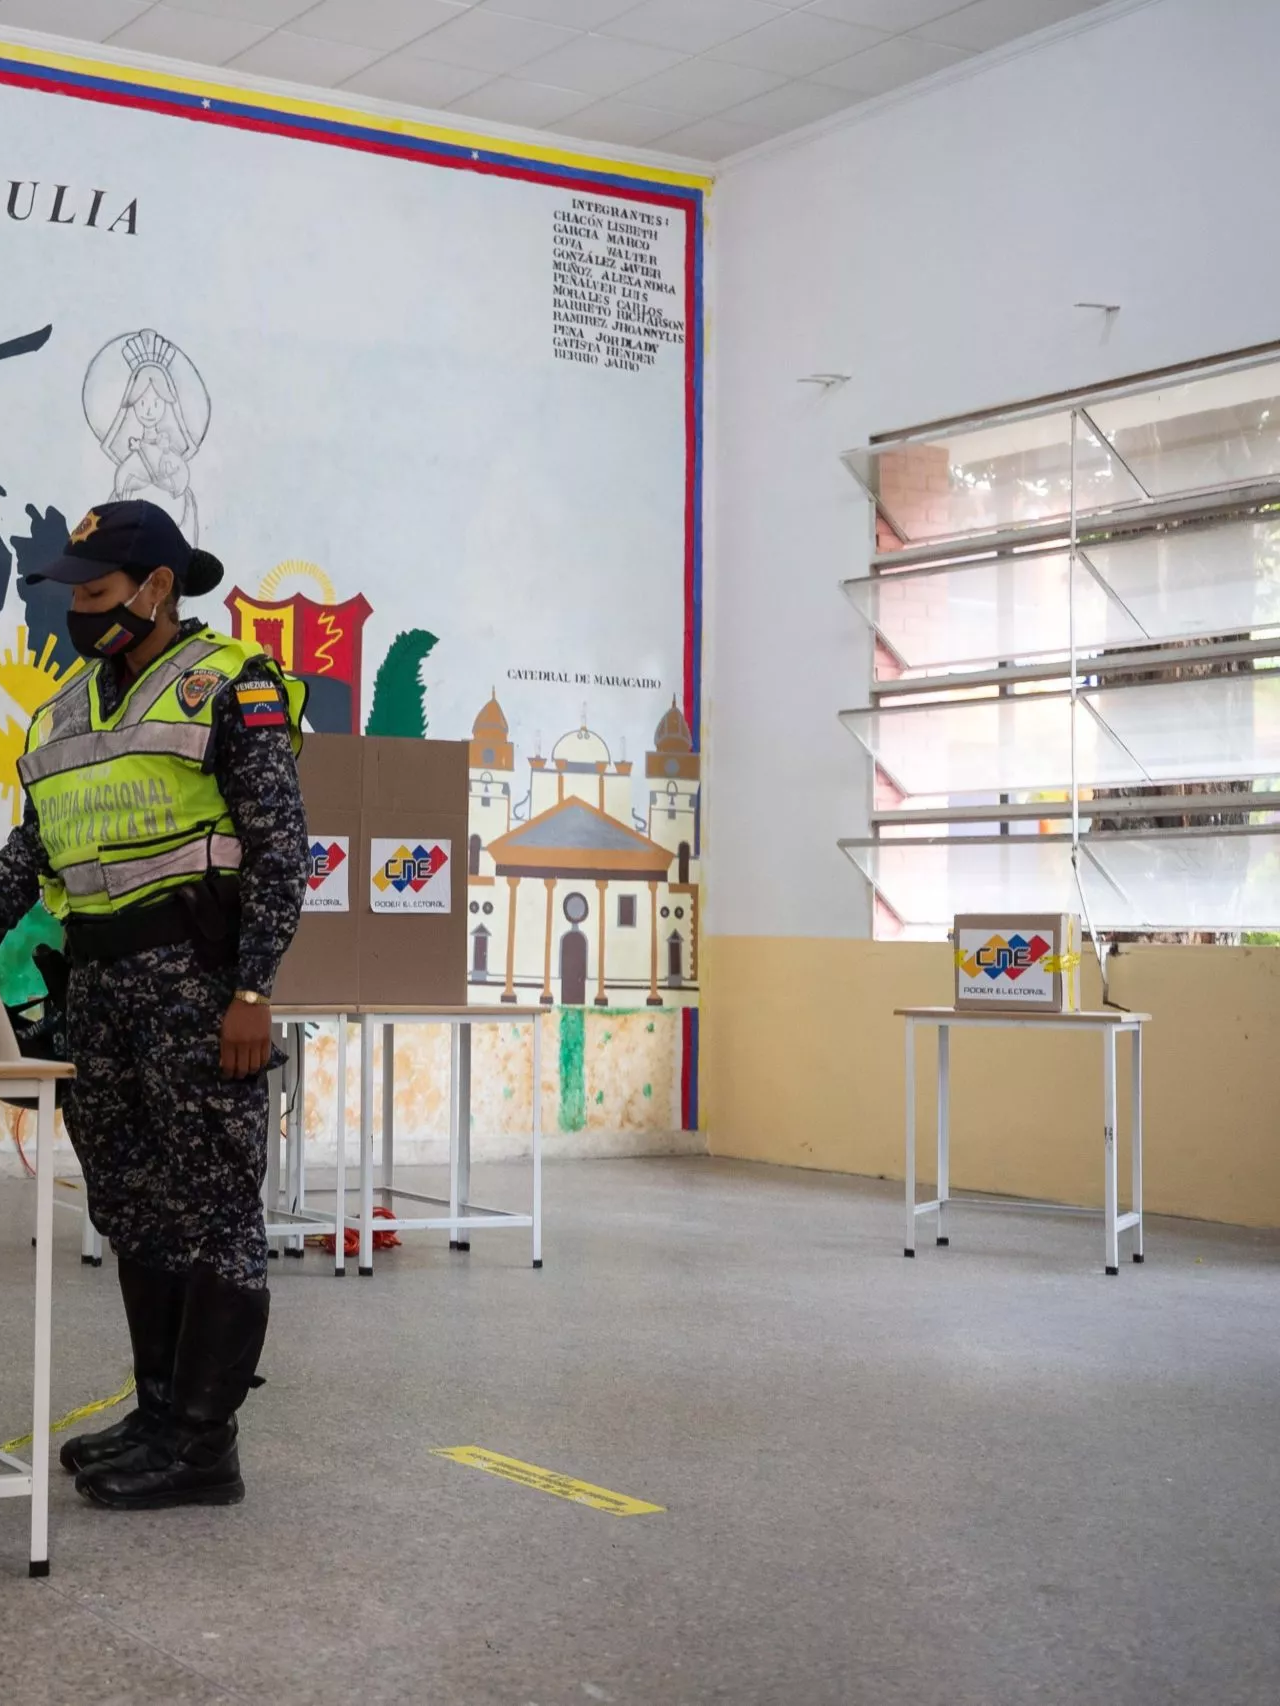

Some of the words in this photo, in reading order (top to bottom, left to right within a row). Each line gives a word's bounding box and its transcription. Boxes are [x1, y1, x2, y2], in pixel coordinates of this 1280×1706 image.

[553, 210, 603, 229] CHACÓN
[607, 221, 658, 241] LISBETH
[553, 236, 583, 251] COVA
[606, 245, 658, 266] WALTER
[607, 233, 650, 250] MARCO
[553, 247, 617, 269] GONZÁLEZ
[620, 263, 661, 280] JAVIER
[552, 260, 592, 279] MUÑOZ
[601, 270, 677, 295] ALEXANDRA
[553, 272, 617, 295] PEÑALVER
[622, 287, 649, 303] LUIS
[553, 285, 610, 306] MORALES
[616, 299, 663, 318] CARLOS
[553, 298, 612, 317] BARRETO
[553, 311, 608, 329] RAMIREZ
[554, 348, 599, 365] BERRIO
[605, 357, 640, 373] JAIRO
[606, 345, 655, 365] HENDER
[234, 681, 275, 691] VENEZUELA
[507, 669, 570, 683] CATEDRAL
[575, 673, 590, 685] DE
[594, 674, 662, 690] MARACAIBO
[83, 777, 173, 813] NACIONAL
[384, 858, 433, 880] CNE
[374, 900, 401, 908] PODER
[402, 900, 445, 909] ELECTORAL
[976, 947, 1033, 967] CNE
[963, 986, 993, 995] PODER
[996, 987, 1046, 996] ELECTORAL
